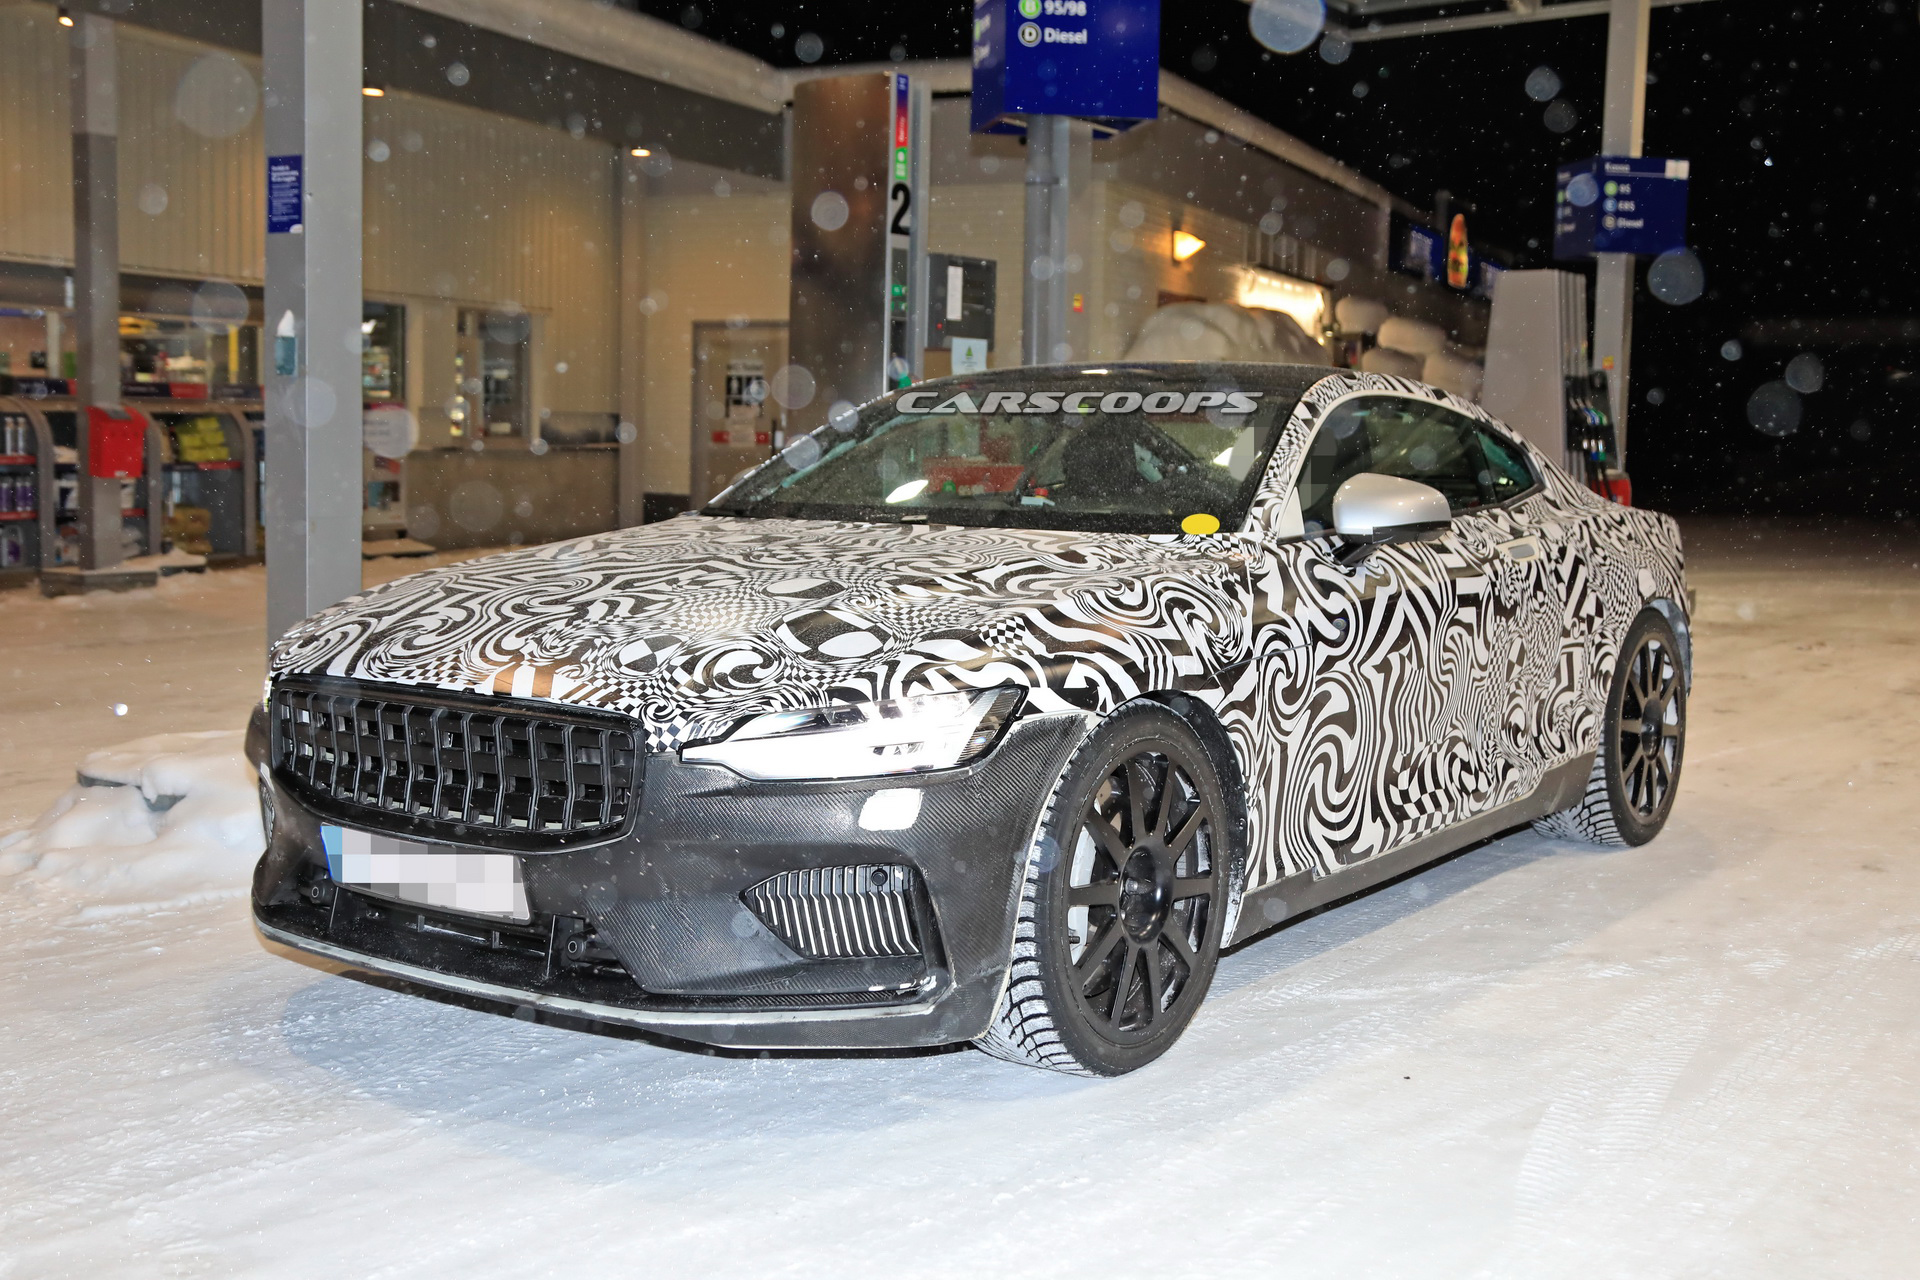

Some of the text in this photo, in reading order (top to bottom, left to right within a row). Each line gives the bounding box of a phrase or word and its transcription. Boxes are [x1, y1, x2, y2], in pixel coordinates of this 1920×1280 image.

[1044, 0, 1087, 16] 95/98
[1024, 26, 1088, 44] D Diesel
[891, 181, 911, 235] 2
